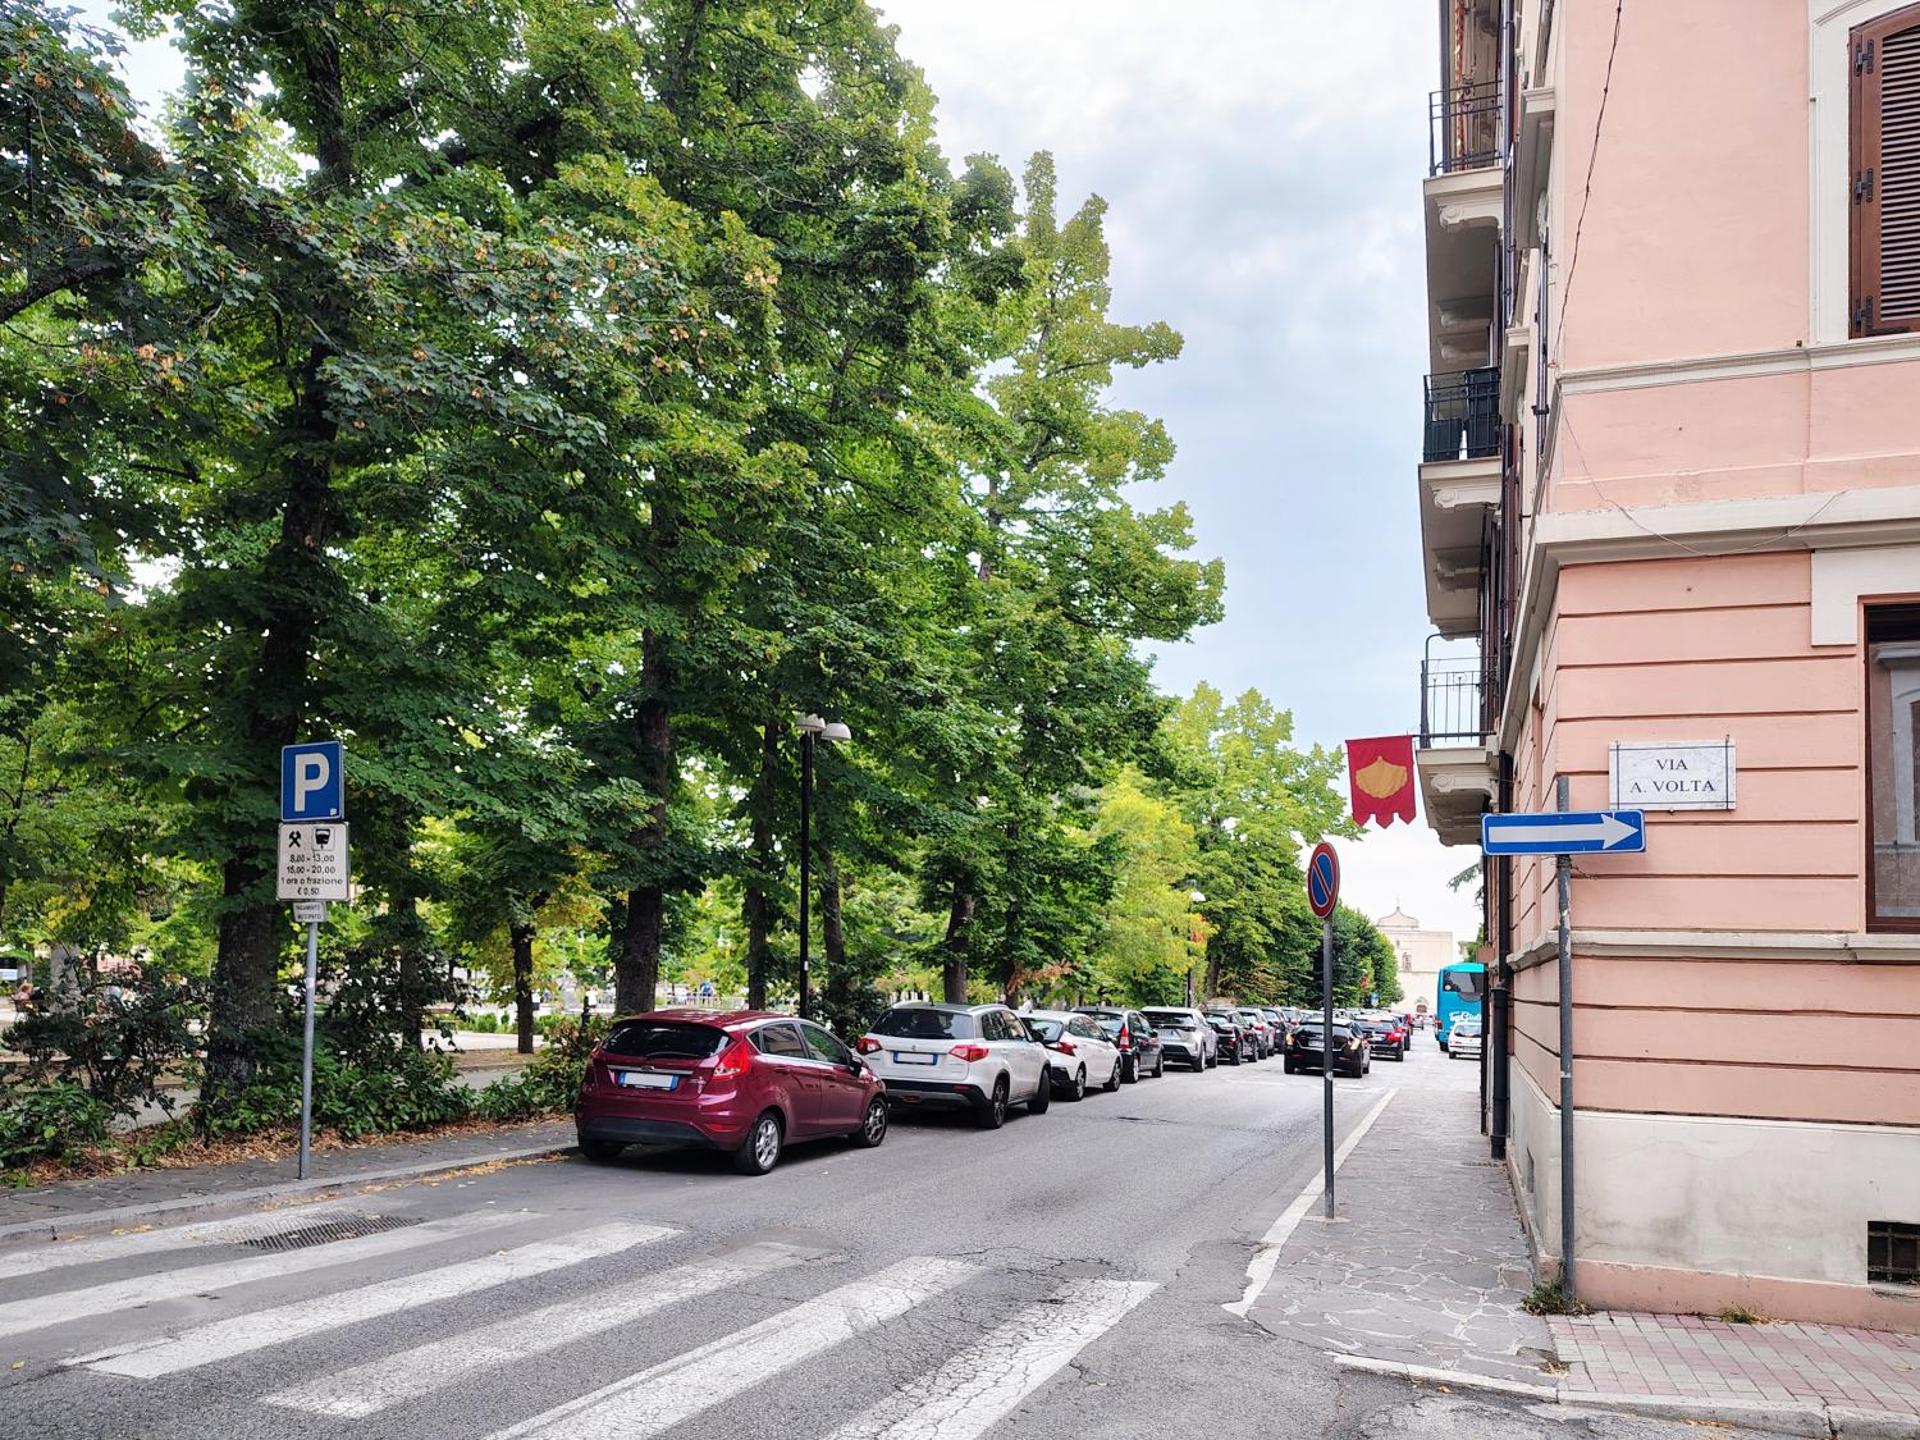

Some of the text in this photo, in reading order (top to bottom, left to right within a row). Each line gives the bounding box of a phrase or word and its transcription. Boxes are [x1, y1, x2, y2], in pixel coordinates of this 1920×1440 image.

[1656, 759, 1688, 770] VIA
[294, 753, 330, 812] P
[1653, 780, 1715, 792] VOLTA
[307, 876, 343, 885] frazione
